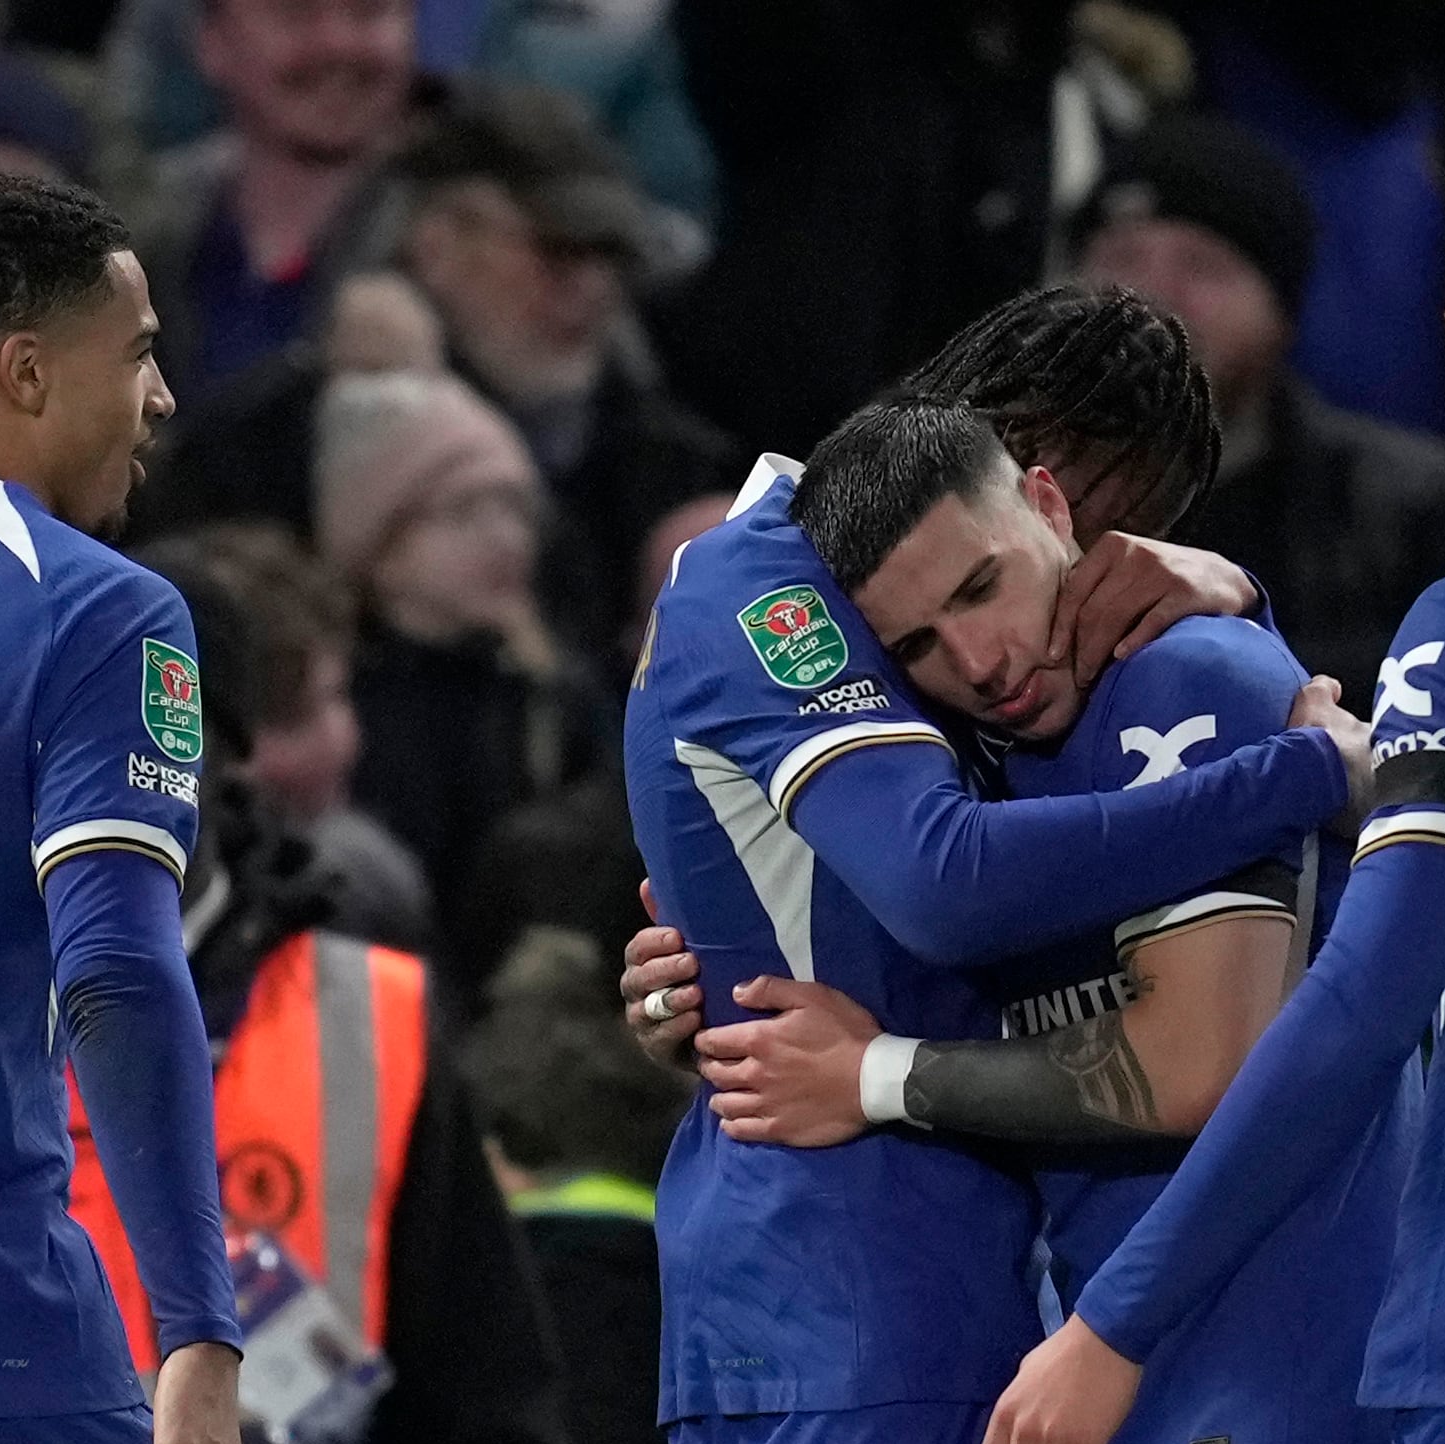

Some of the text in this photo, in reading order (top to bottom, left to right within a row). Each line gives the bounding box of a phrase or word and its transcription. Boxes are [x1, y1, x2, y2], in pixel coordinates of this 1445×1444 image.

[765, 618, 829, 662] Carabao
[787, 636, 820, 660] Cup
[813, 657, 837, 673] EFL
[149, 692, 199, 716] Carabao
[818, 679, 875, 710] room
[165, 709, 189, 728] Cup
[176, 738, 193, 755] EFL
[129, 752, 157, 776] No
[129, 769, 157, 790] for
